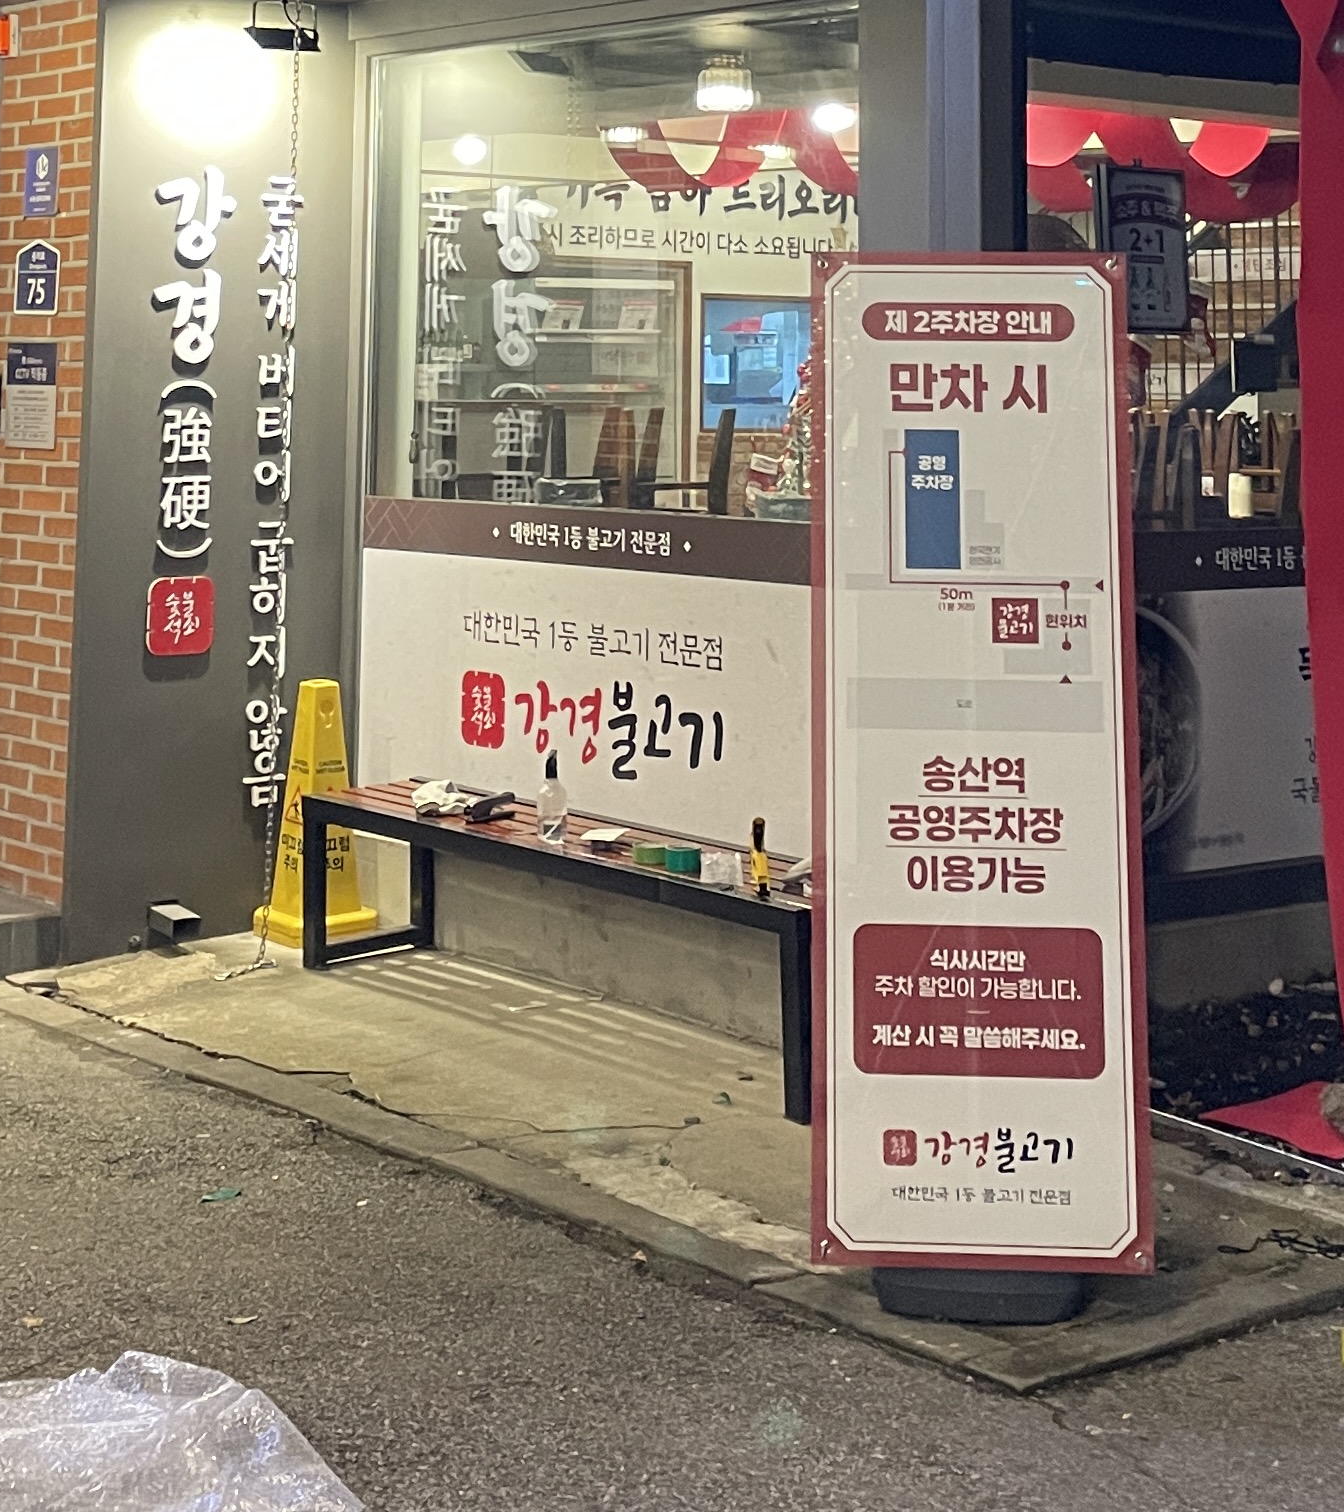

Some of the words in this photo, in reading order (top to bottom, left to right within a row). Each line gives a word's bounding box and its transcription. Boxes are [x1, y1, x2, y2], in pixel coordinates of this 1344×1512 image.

[568, 224, 656, 250] 조리하므로
[661, 228, 711, 255] 시간이
[717, 232, 749, 256] 다소
[26, 277, 46, 305] 75
[884, 310, 908, 334] 제
[913, 310, 1001, 335] 2주차장
[1005, 310, 1053, 335] 안내
[890, 363, 989, 413] 만차
[1002, 364, 1048, 414] 시
[917, 455, 946, 471] 공영
[911, 474, 954, 491] 주차장
[510, 521, 560, 547] 대한민국
[563, 525, 583, 550] 1등
[586, 527, 627, 552] 불고기
[629, 530, 672, 557] 전문점
[1214, 546, 1273, 571] 대한민국
[940, 587, 974, 600] 50m
[999, 603, 1029, 620] 강경
[463, 609, 541, 649] 대한민국
[548, 620, 579, 653] 1등
[587, 623, 650, 662] 불고기
[658, 631, 724, 672] 전문점
[997, 619, 1034, 639] 불고기
[514, 679, 725, 781] 강경불고기
[922, 755, 1026, 794] 송산역
[887, 804, 1064, 844] 공영주차장
[906, 855, 1046, 894] 이용가능
[929, 948, 1026, 973] 식사시간만
[874, 974, 914, 998] 주차
[918, 976, 975, 999] 할인이
[980, 977, 1082, 1001] 가능합니다.
[872, 1024, 912, 1048] 계산
[915, 1024, 935, 1048] 시
[938, 1025, 959, 1048] 꼭
[963, 1026, 1086, 1051] 말씀해주세요.
[924, 1127, 1074, 1174] 강경불고기
